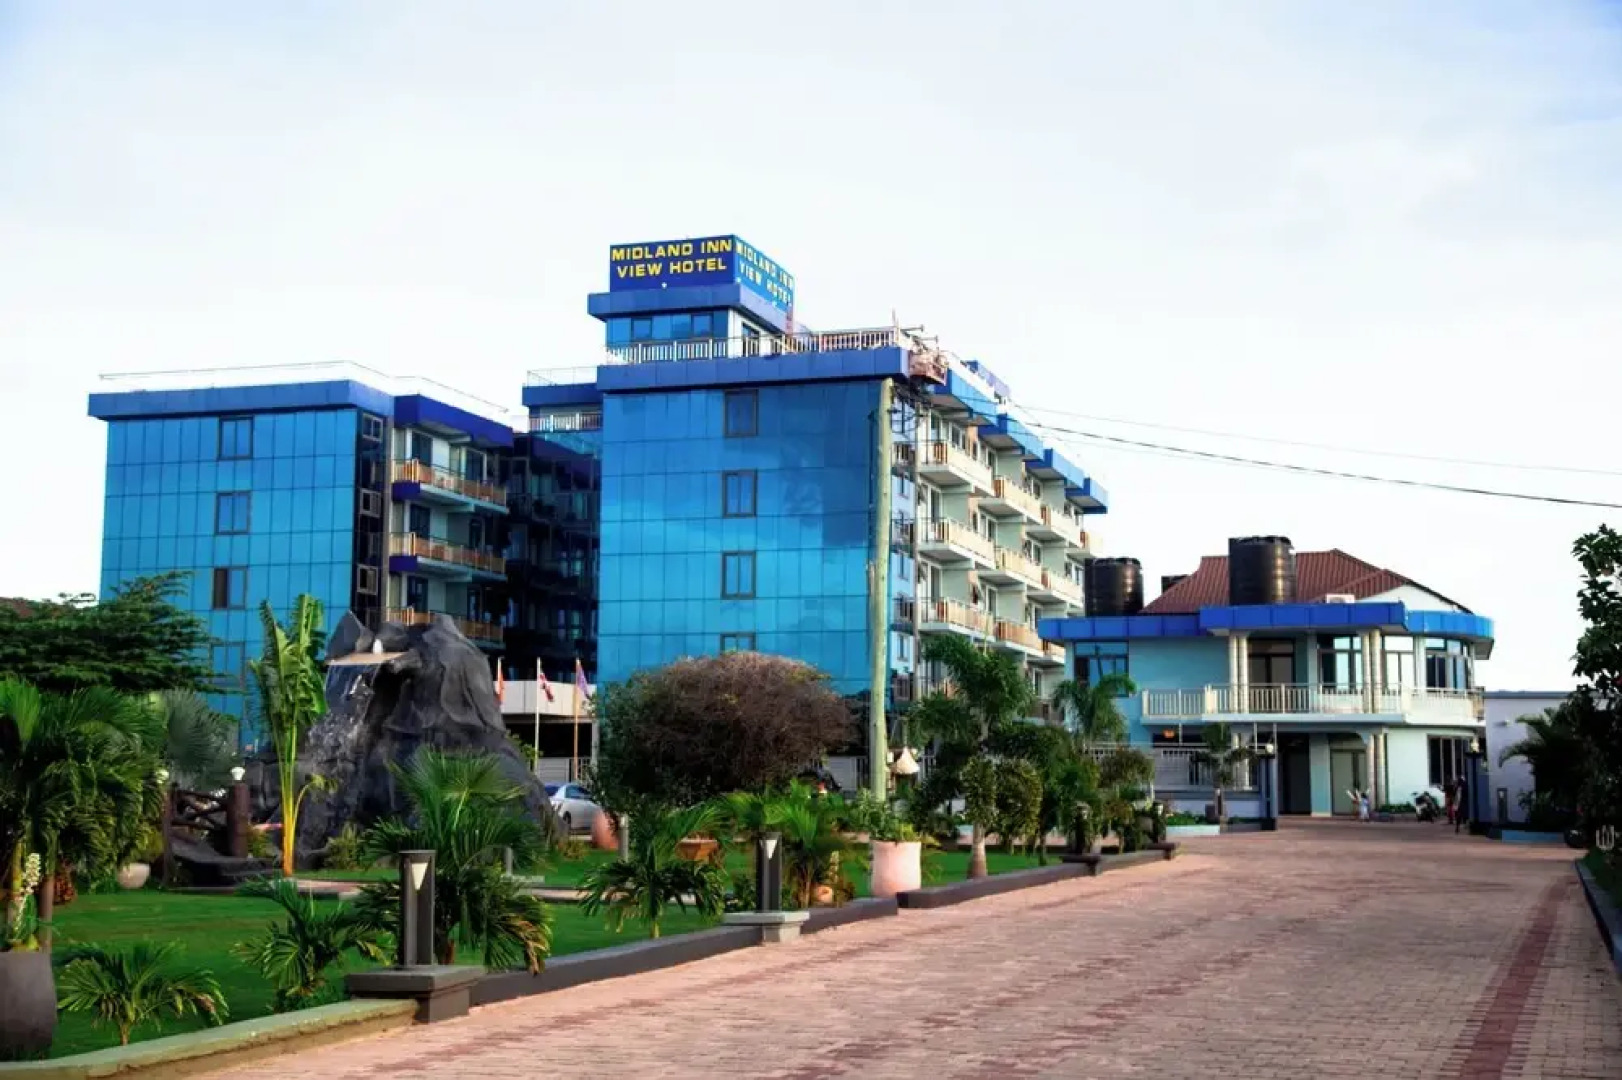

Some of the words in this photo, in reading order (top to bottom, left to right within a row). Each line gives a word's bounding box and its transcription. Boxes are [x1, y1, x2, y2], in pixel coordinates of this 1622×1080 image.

[612, 243, 693, 261] MIDLAND
[701, 239, 732, 254] INN
[617, 263, 662, 278] VIEW
[669, 258, 727, 274] HOTEL
